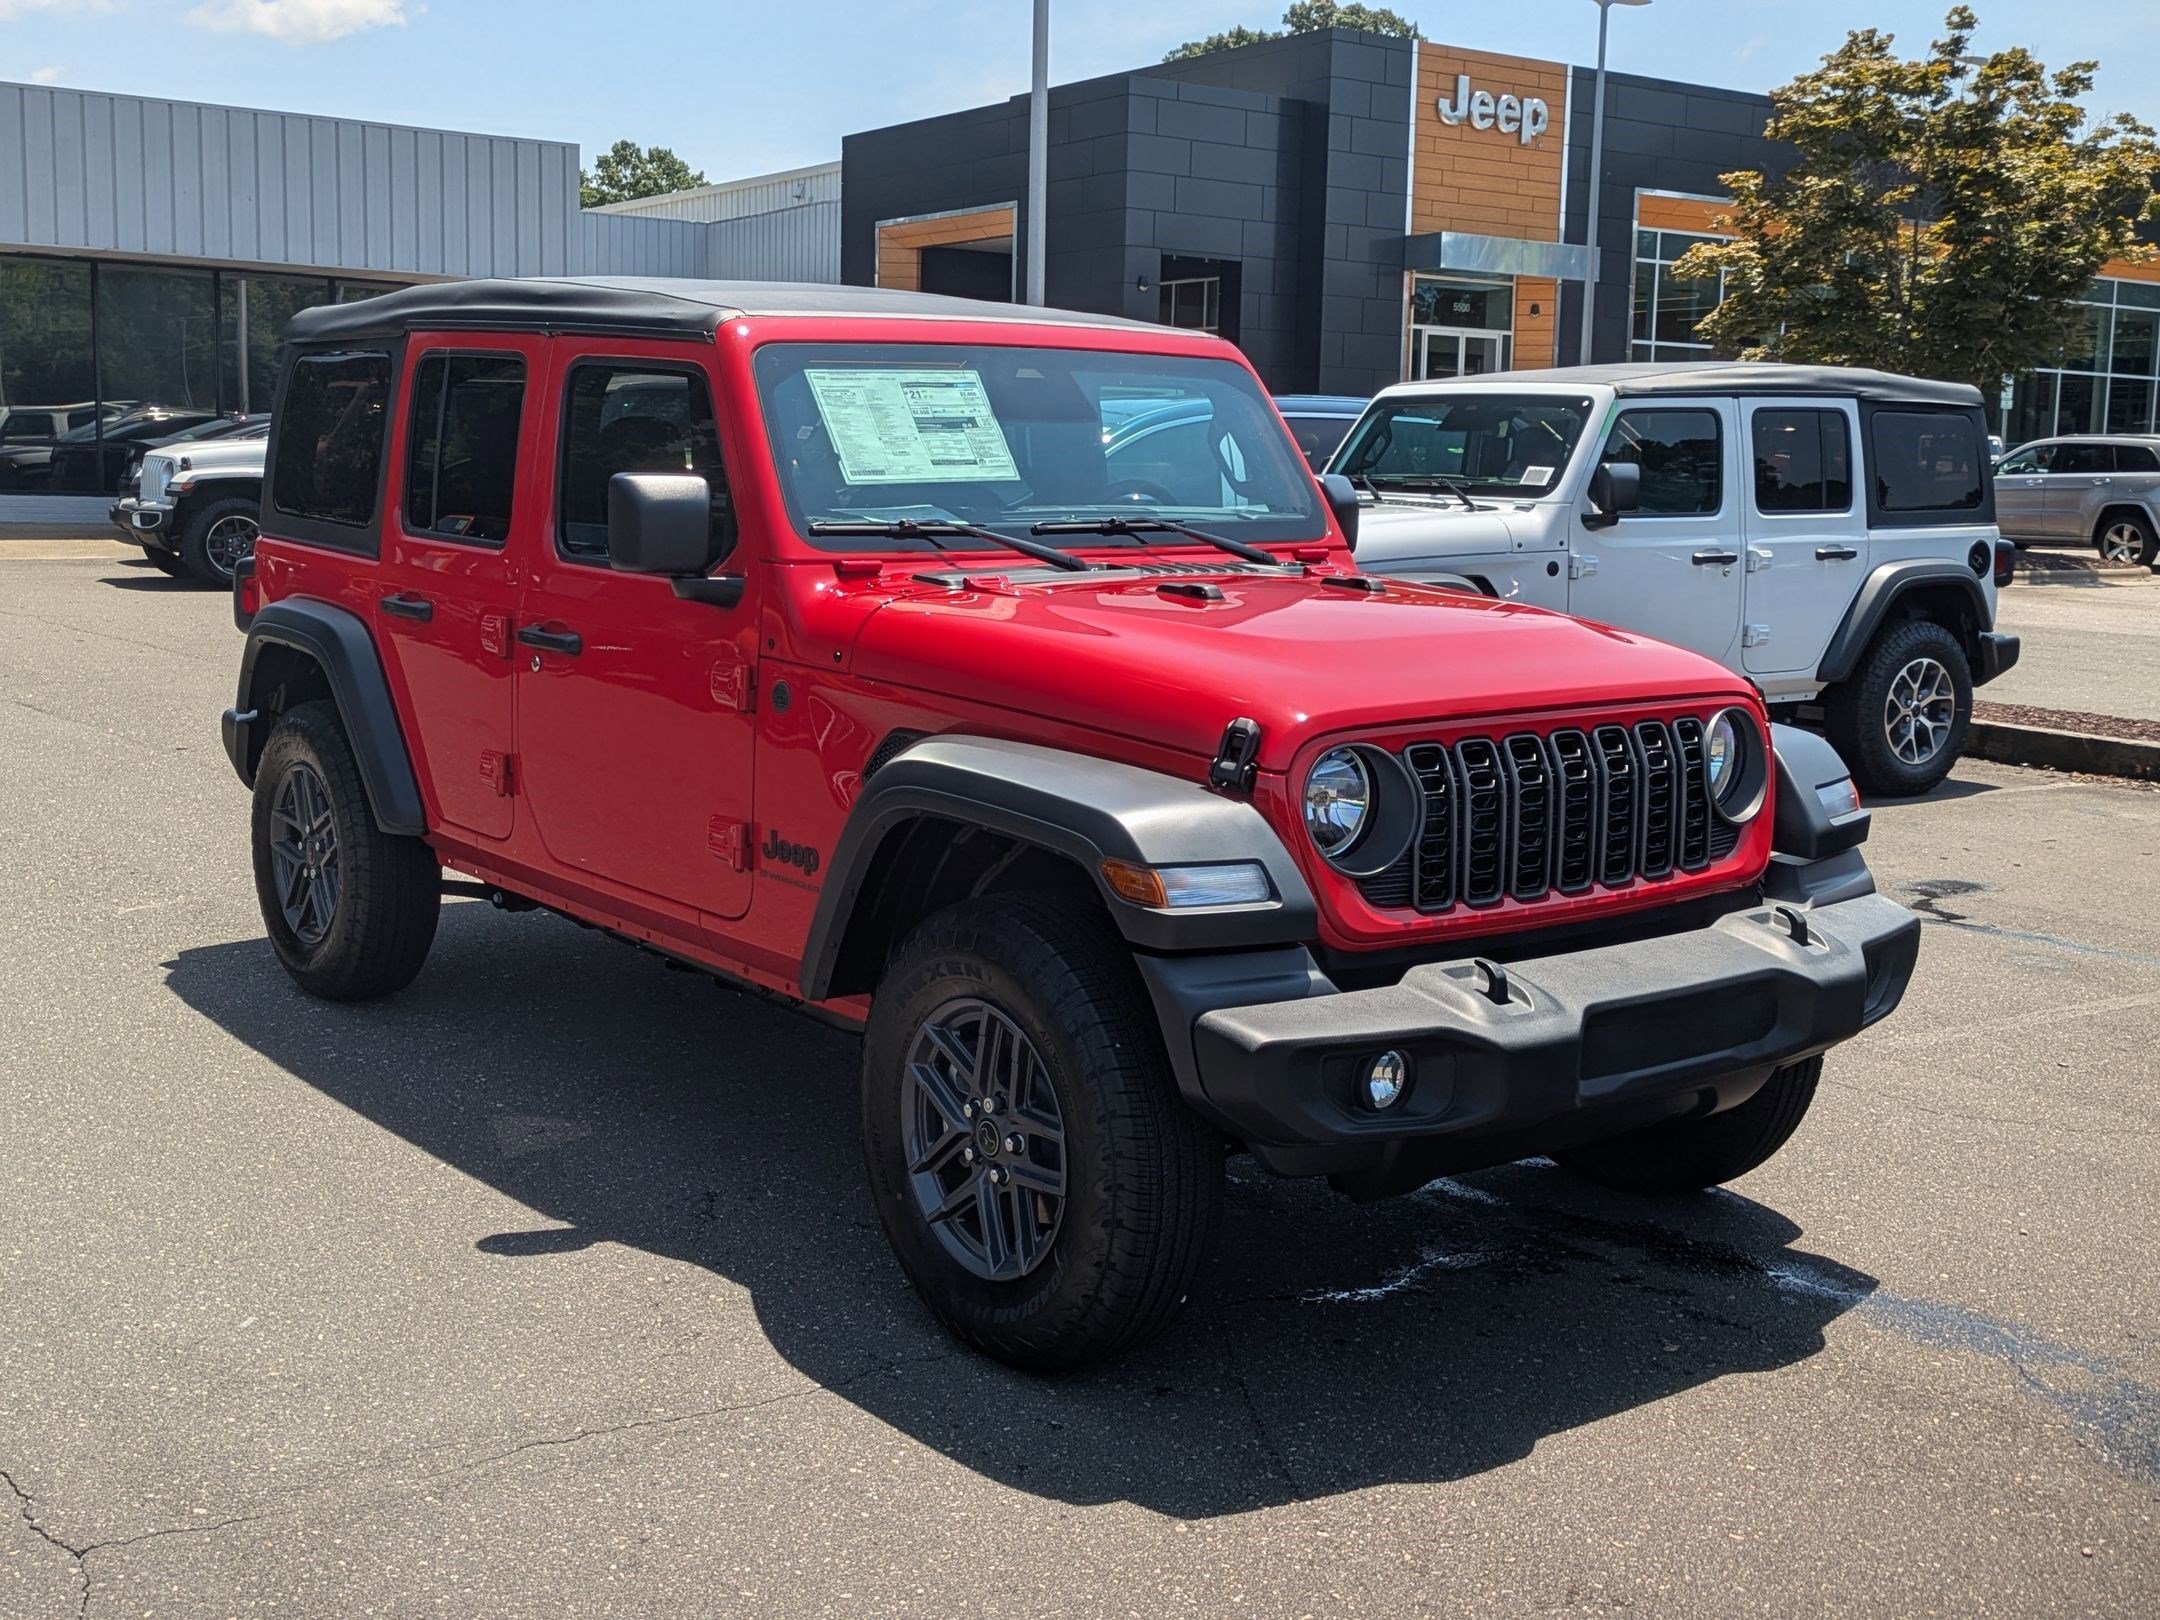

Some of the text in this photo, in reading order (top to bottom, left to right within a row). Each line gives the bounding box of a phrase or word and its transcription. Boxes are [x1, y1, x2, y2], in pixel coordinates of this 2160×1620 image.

[1438, 75, 1549, 145] Jeep
[909, 390, 922, 400] 21
[762, 829, 820, 877] Jeep
[894, 961, 986, 1009] NEXEN
